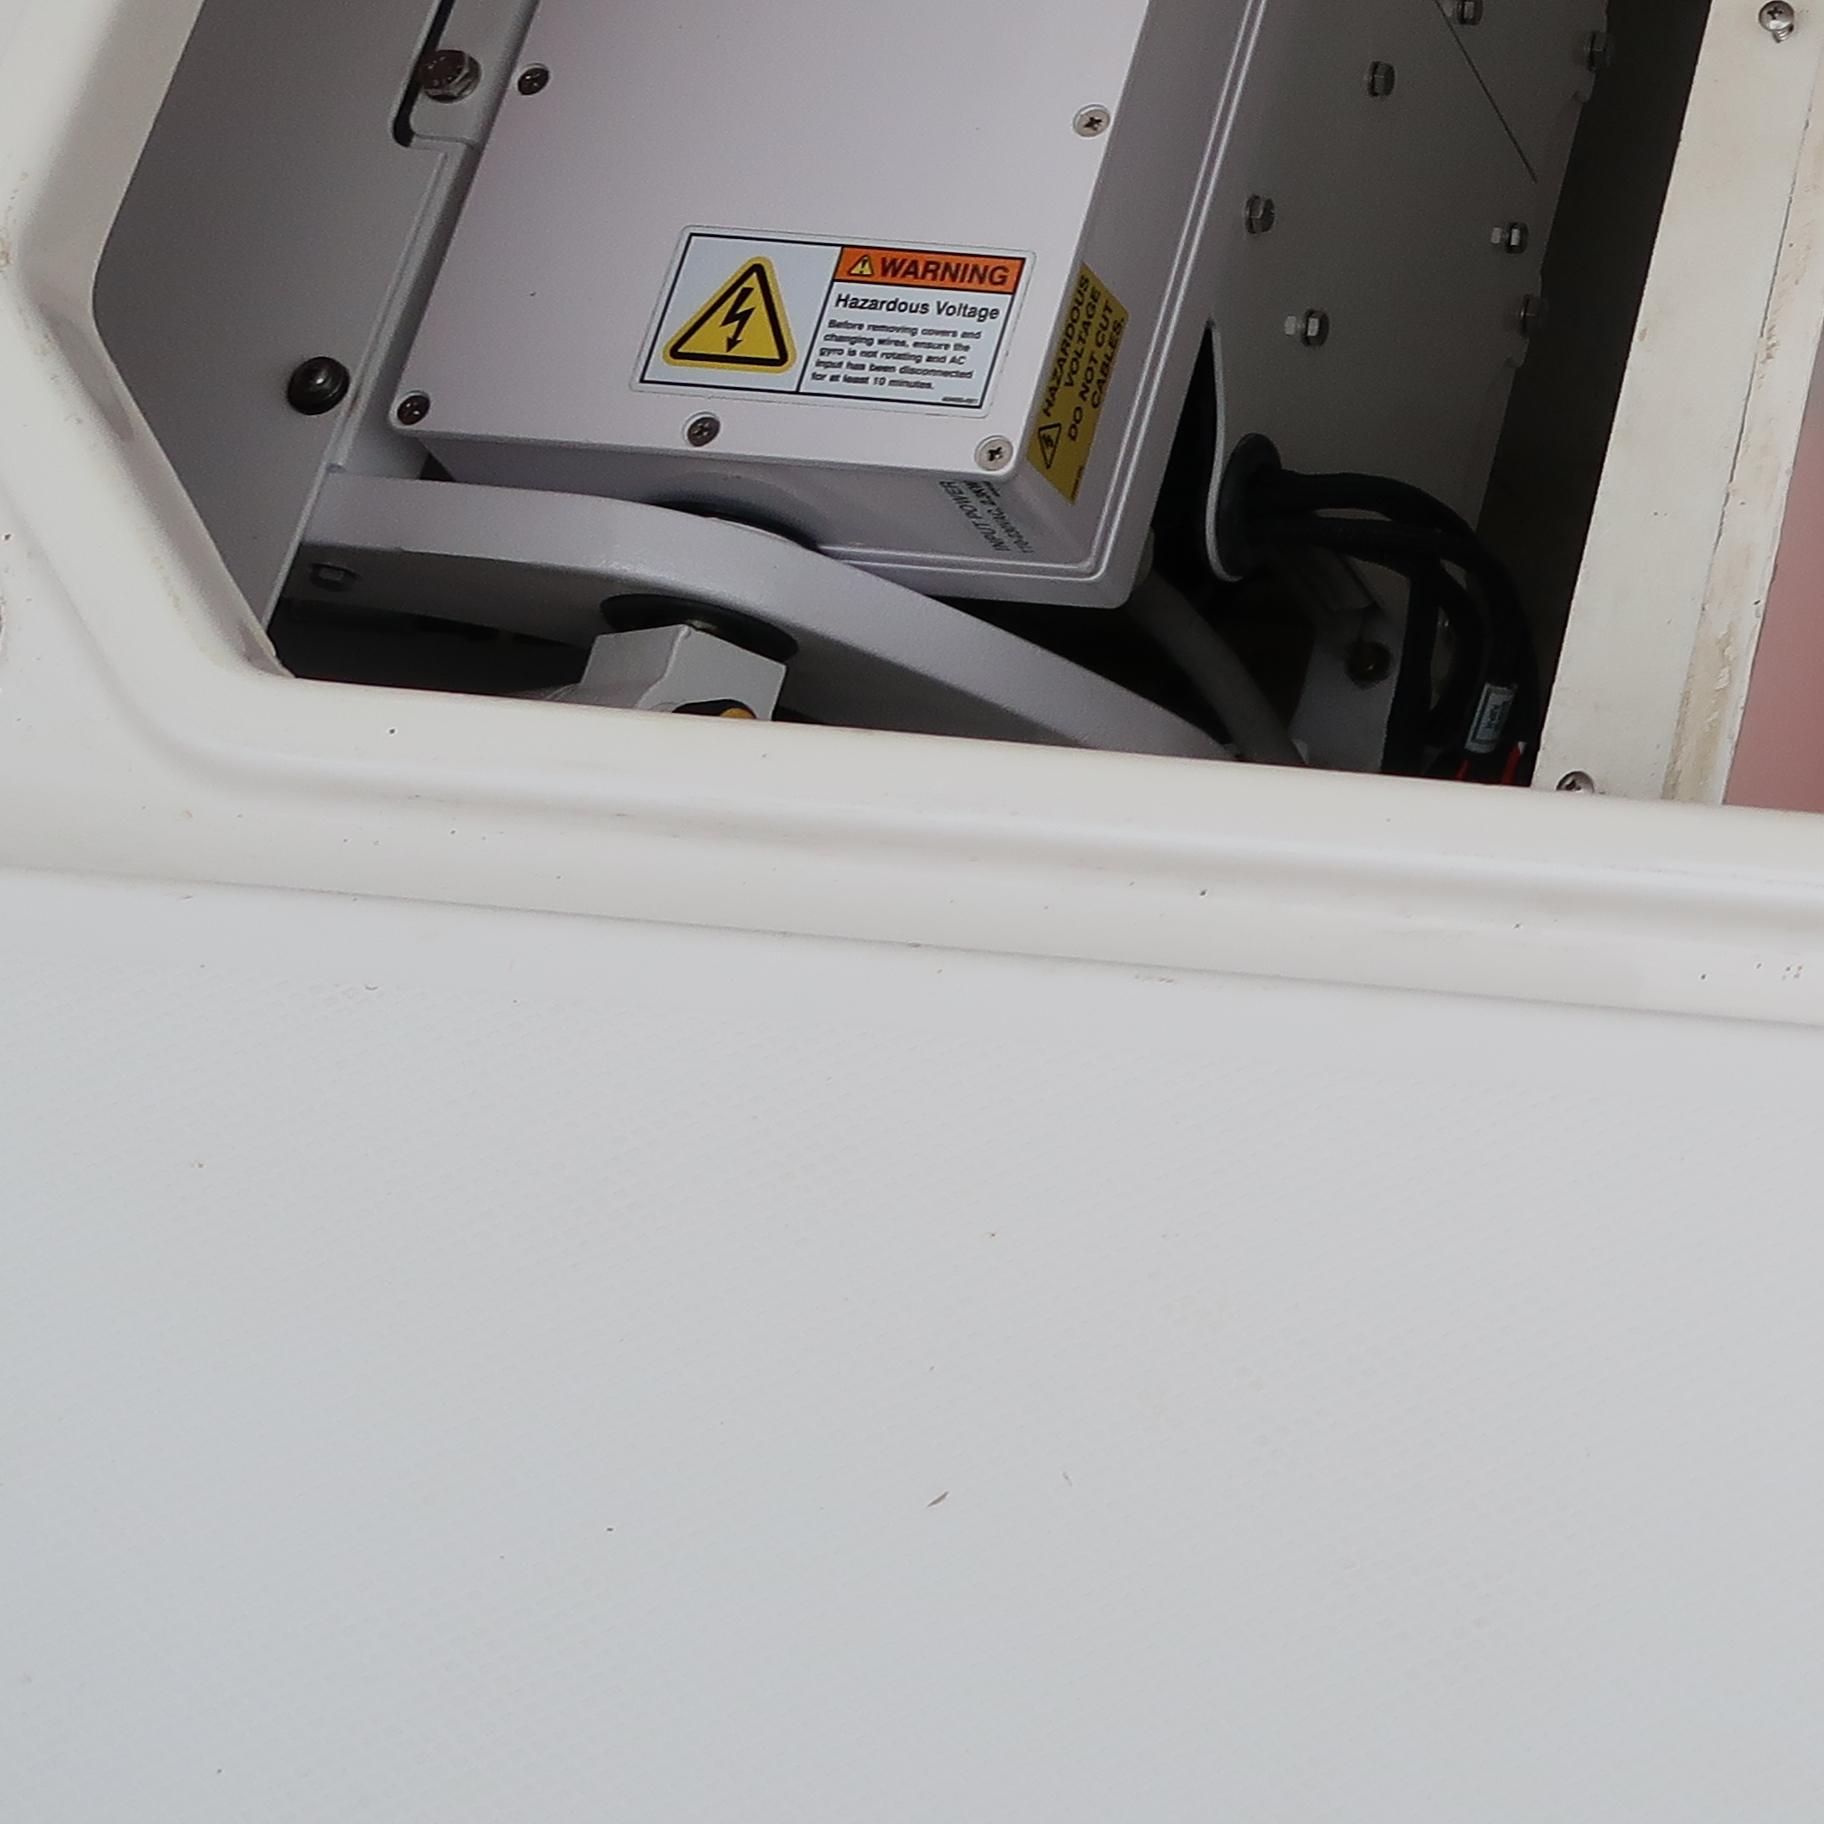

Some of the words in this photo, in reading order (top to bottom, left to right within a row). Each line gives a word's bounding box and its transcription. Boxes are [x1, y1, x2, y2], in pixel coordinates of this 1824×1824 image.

[881, 257, 1009, 286] WARNING
[835, 294, 929, 314] Hazardous
[937, 301, 1000, 322] Voltage
[824, 333, 874, 346] changing
[913, 341, 951, 351] ensure
[953, 342, 970, 352] the
[828, 319, 864, 330] Before
[867, 324, 918, 336] removing
[921, 328, 958, 338] covers
[961, 330, 982, 339] and
[1064, 286, 1101, 388] VOLTAGE
[819, 347, 843, 357] gyro
[848, 348, 857, 357] is
[860, 349, 878, 358] not
[880, 350, 923, 364] rotating
[926, 354, 947, 364] and
[949, 356, 967, 365] AC
[1043, 275, 1090, 417] HAZARDOUS
[815, 359, 843, 370] input
[846, 362, 866, 371] has
[869, 364, 896, 373] been
[899, 365, 973, 379] disconnected
[1068, 406, 1083, 442] DO
[1078, 350, 1098, 401] NOT
[1095, 300, 1114, 347] CUT
[1091, 318, 1125, 409] CABLES.
[811, 371, 827, 381] for
[829, 374, 841, 382] at
[843, 375, 870, 384] least
[873, 377, 886, 386] 10
[888, 379, 934, 390] minutes.
[939, 480, 983, 519] POWER
[972, 520, 1011, 551] INPUT
